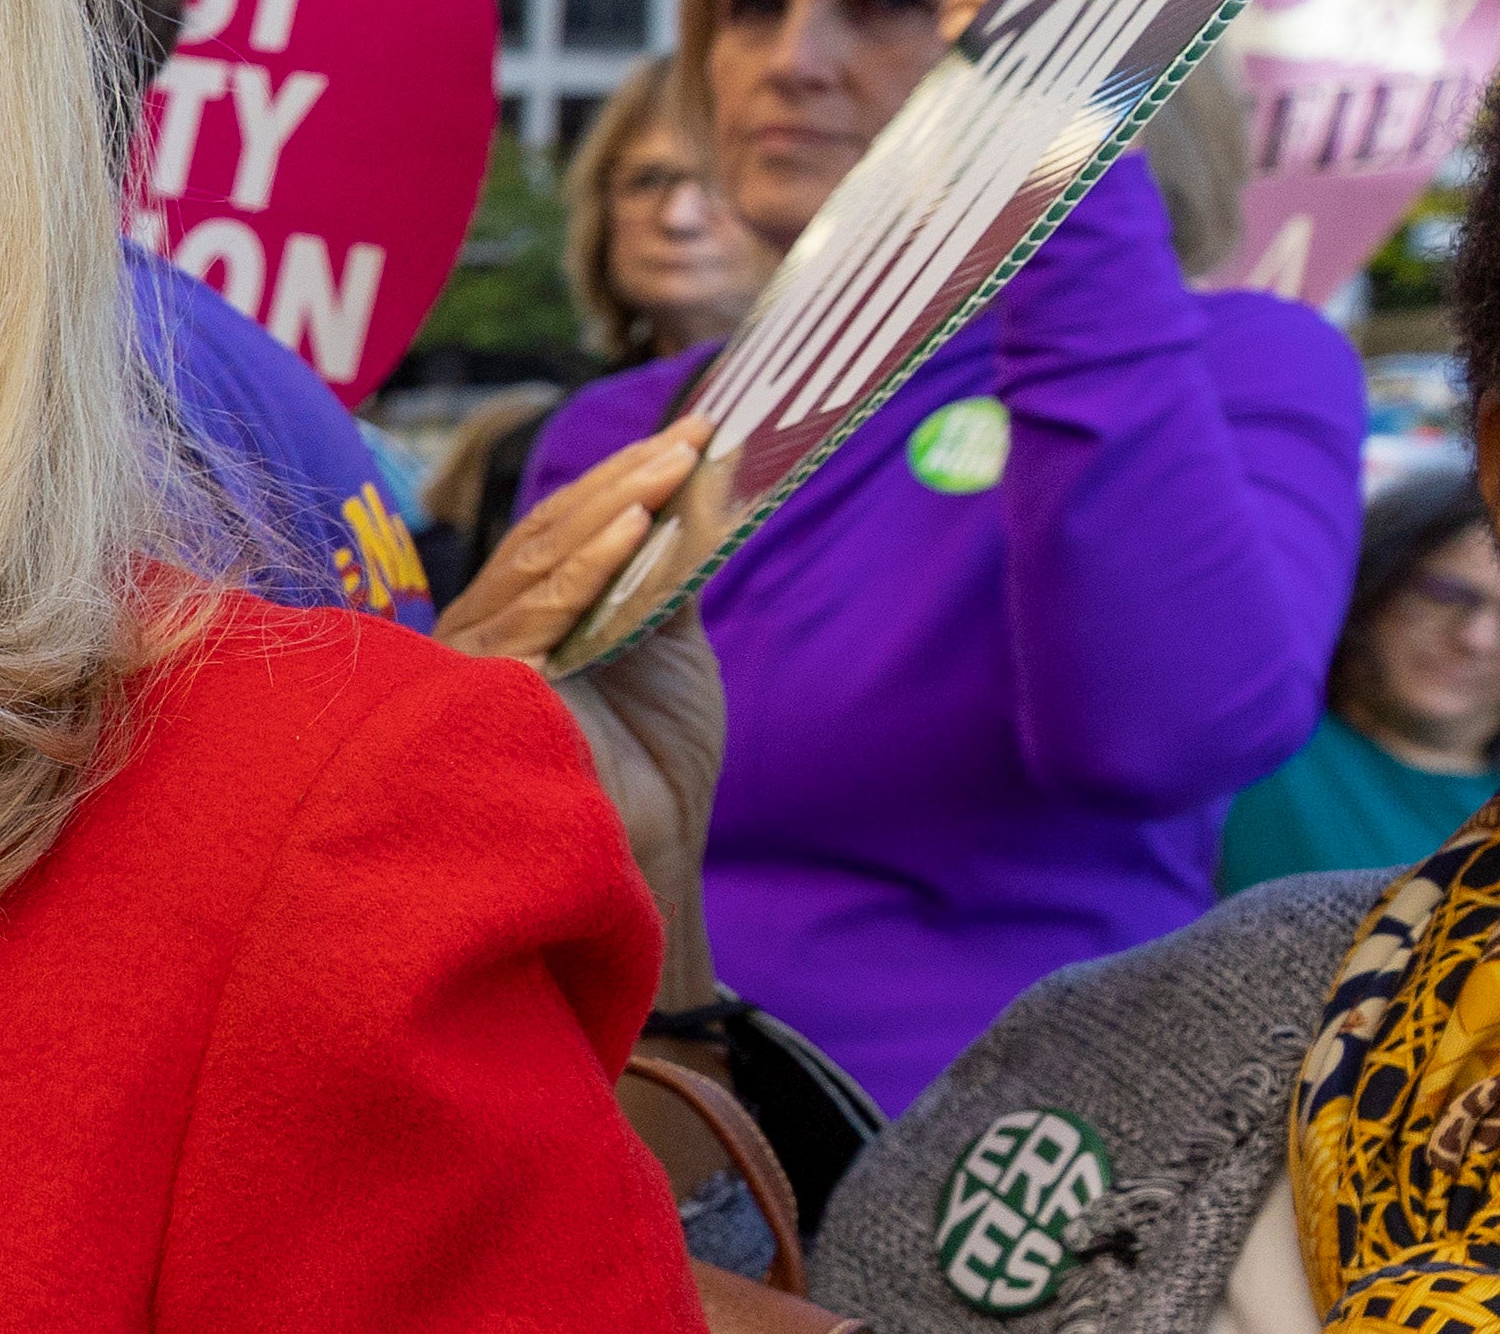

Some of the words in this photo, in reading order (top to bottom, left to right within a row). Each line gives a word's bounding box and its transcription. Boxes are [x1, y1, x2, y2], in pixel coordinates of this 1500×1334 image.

[152, 53, 331, 213] TY
[964, 1110, 1103, 1227] ERA
[934, 1170, 1063, 1307] YES
